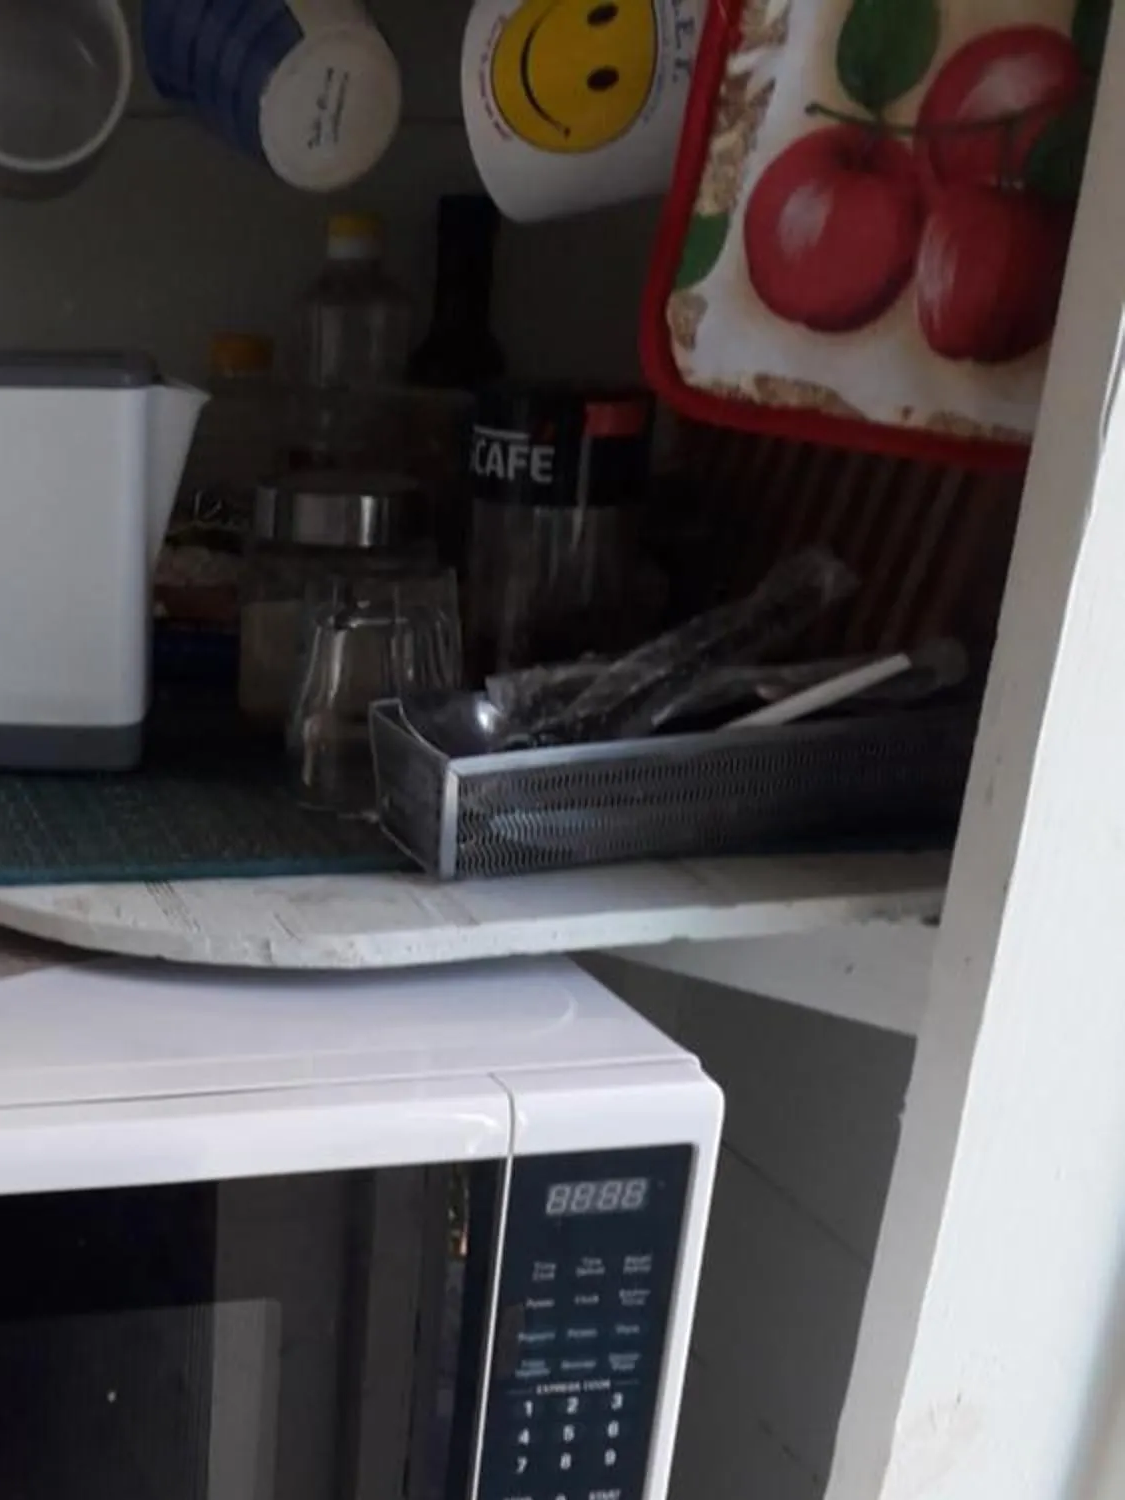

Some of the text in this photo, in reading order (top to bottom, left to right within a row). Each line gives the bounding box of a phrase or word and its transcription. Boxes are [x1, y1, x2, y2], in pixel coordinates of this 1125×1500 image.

[524, 1391, 624, 1419] 1 2 3
[517, 1420, 620, 1446] 4 5 6
[515, 1447, 617, 1474] 7 8 9
